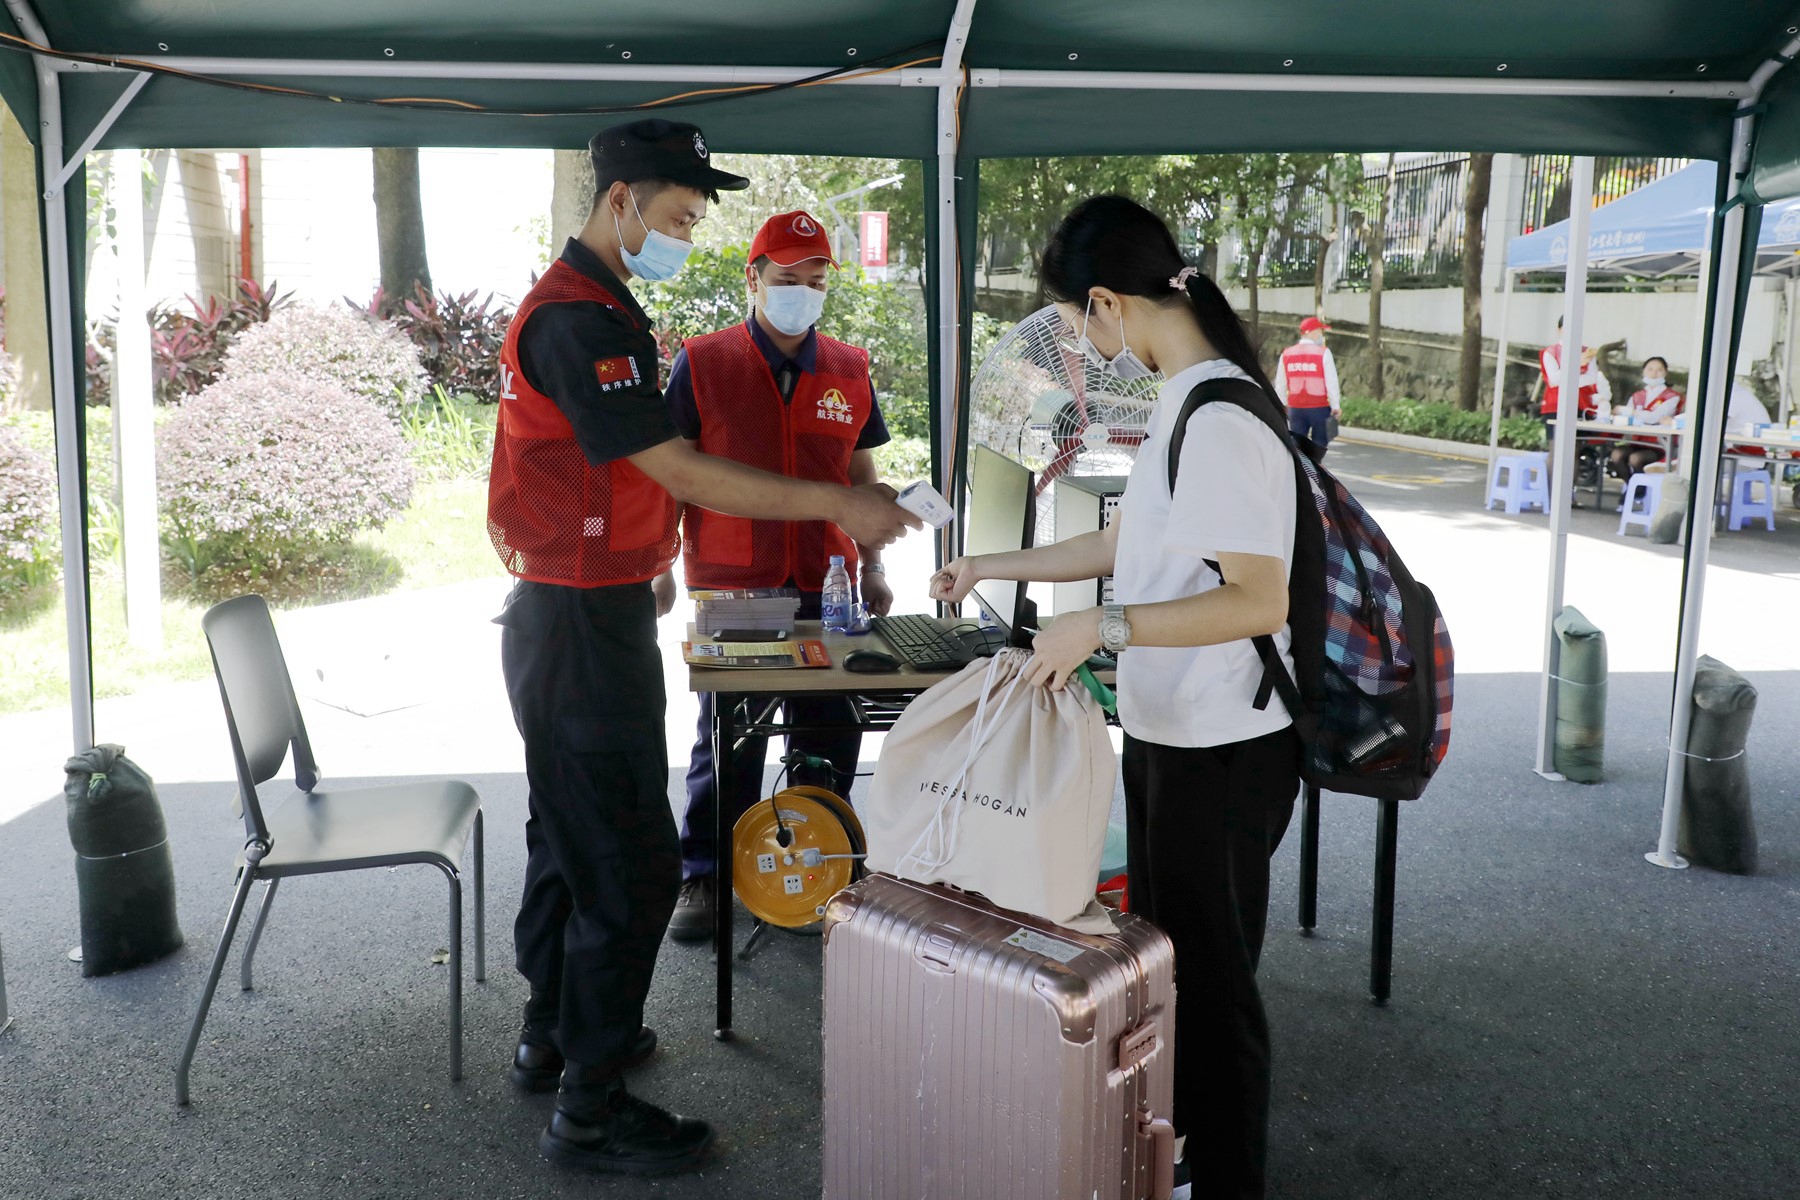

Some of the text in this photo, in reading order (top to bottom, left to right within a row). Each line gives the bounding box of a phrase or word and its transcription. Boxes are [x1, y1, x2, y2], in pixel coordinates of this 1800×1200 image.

[601, 378, 642, 392] 秩序维护
[816, 408, 854, 425] 航天物业
[972, 793, 1027, 818] HOGAN
